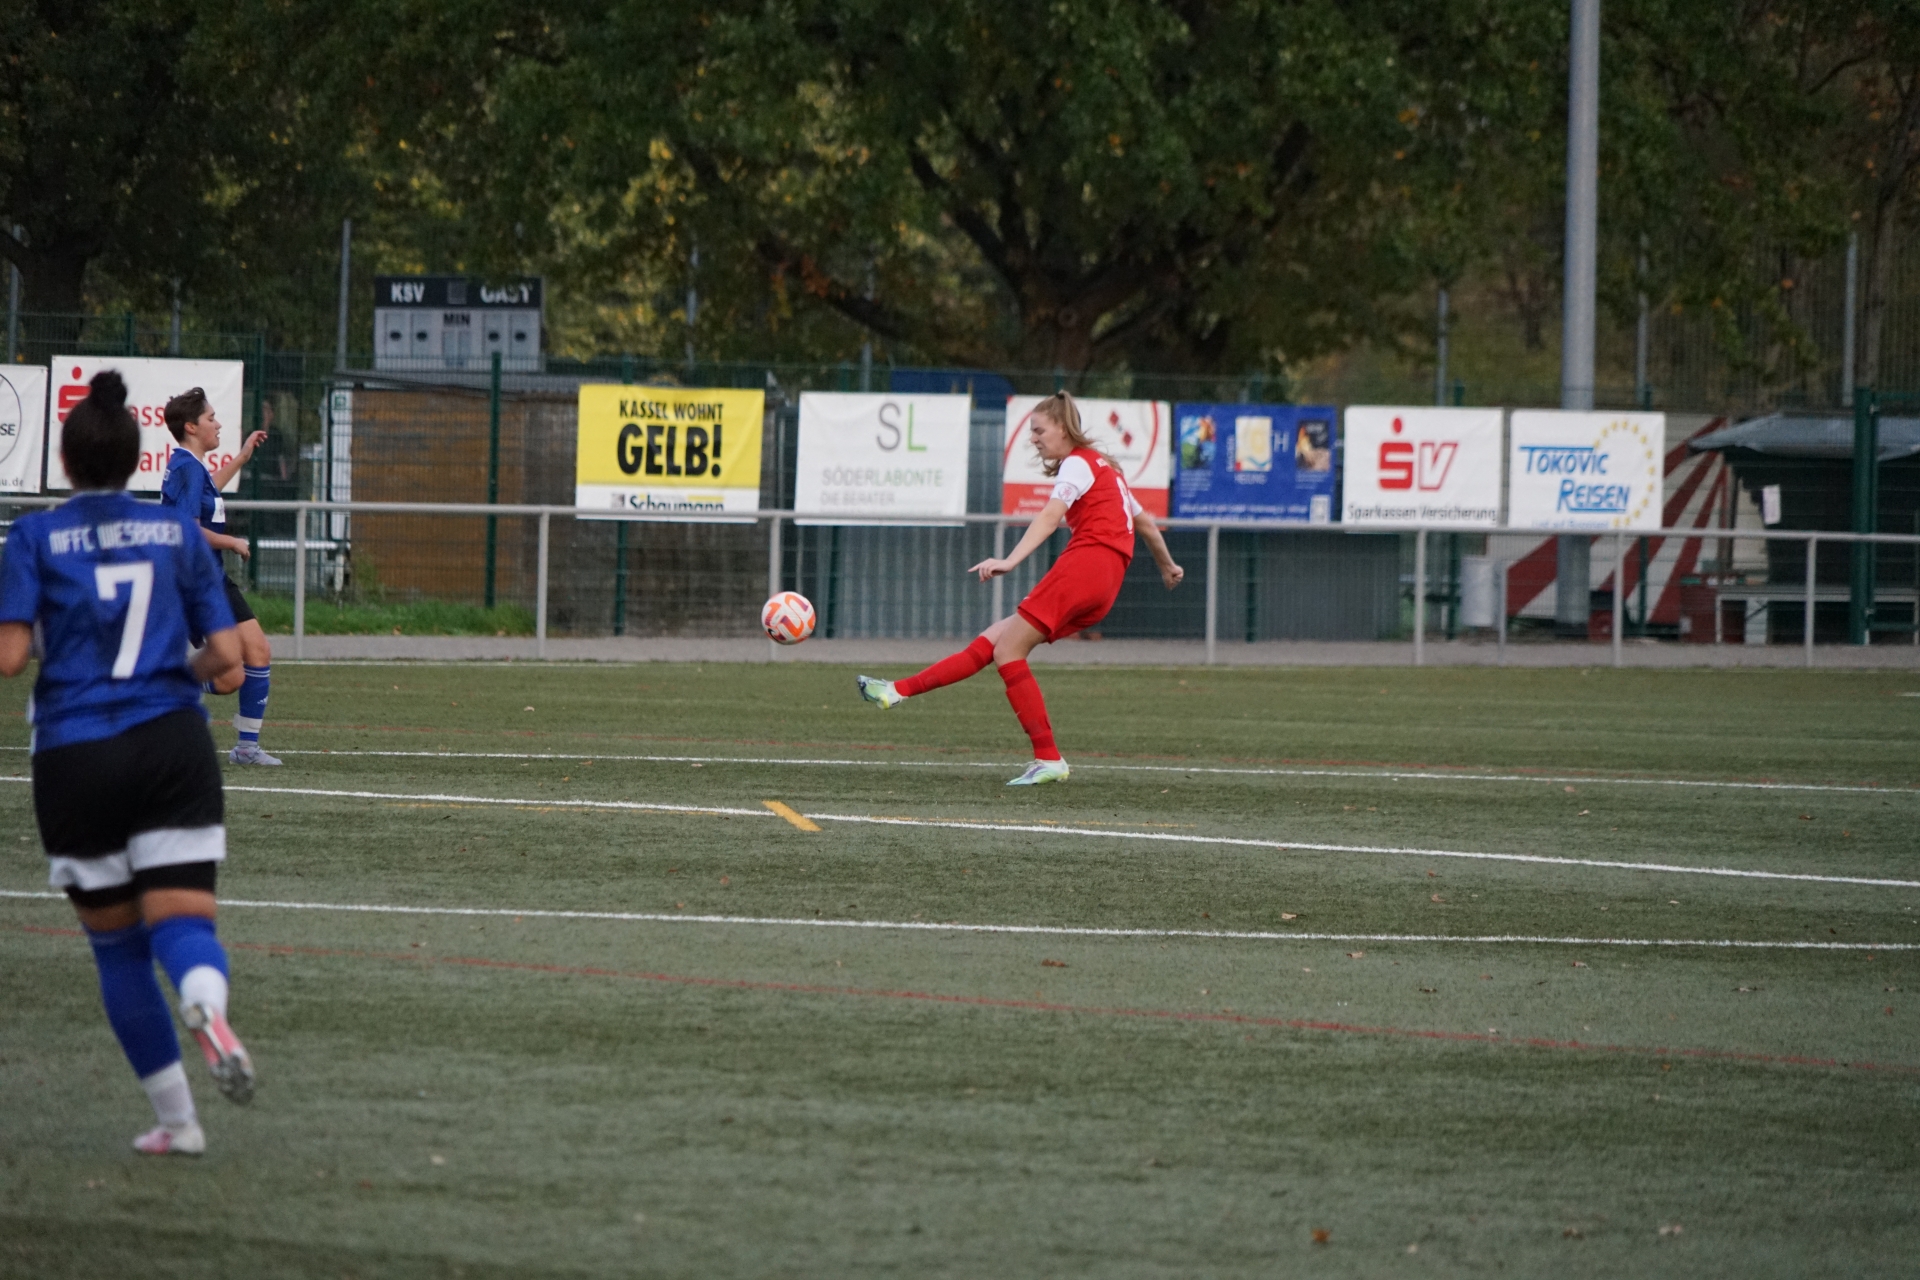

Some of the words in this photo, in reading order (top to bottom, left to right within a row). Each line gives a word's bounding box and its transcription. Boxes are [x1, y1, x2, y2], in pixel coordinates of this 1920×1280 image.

[391, 282, 425, 302] KSV
[443, 313, 471, 327] MIN
[619, 400, 669, 419] KASSEL
[674, 402, 723, 421] WOHNT
[876, 402, 927, 452] SL
[617, 423, 722, 478] GELB!
[0, 477, 24, 487] u.de
[1347, 505, 1416, 522] Sparkassen
[1420, 505, 1497, 523] Versicherung
[95, 561, 154, 679] 7
